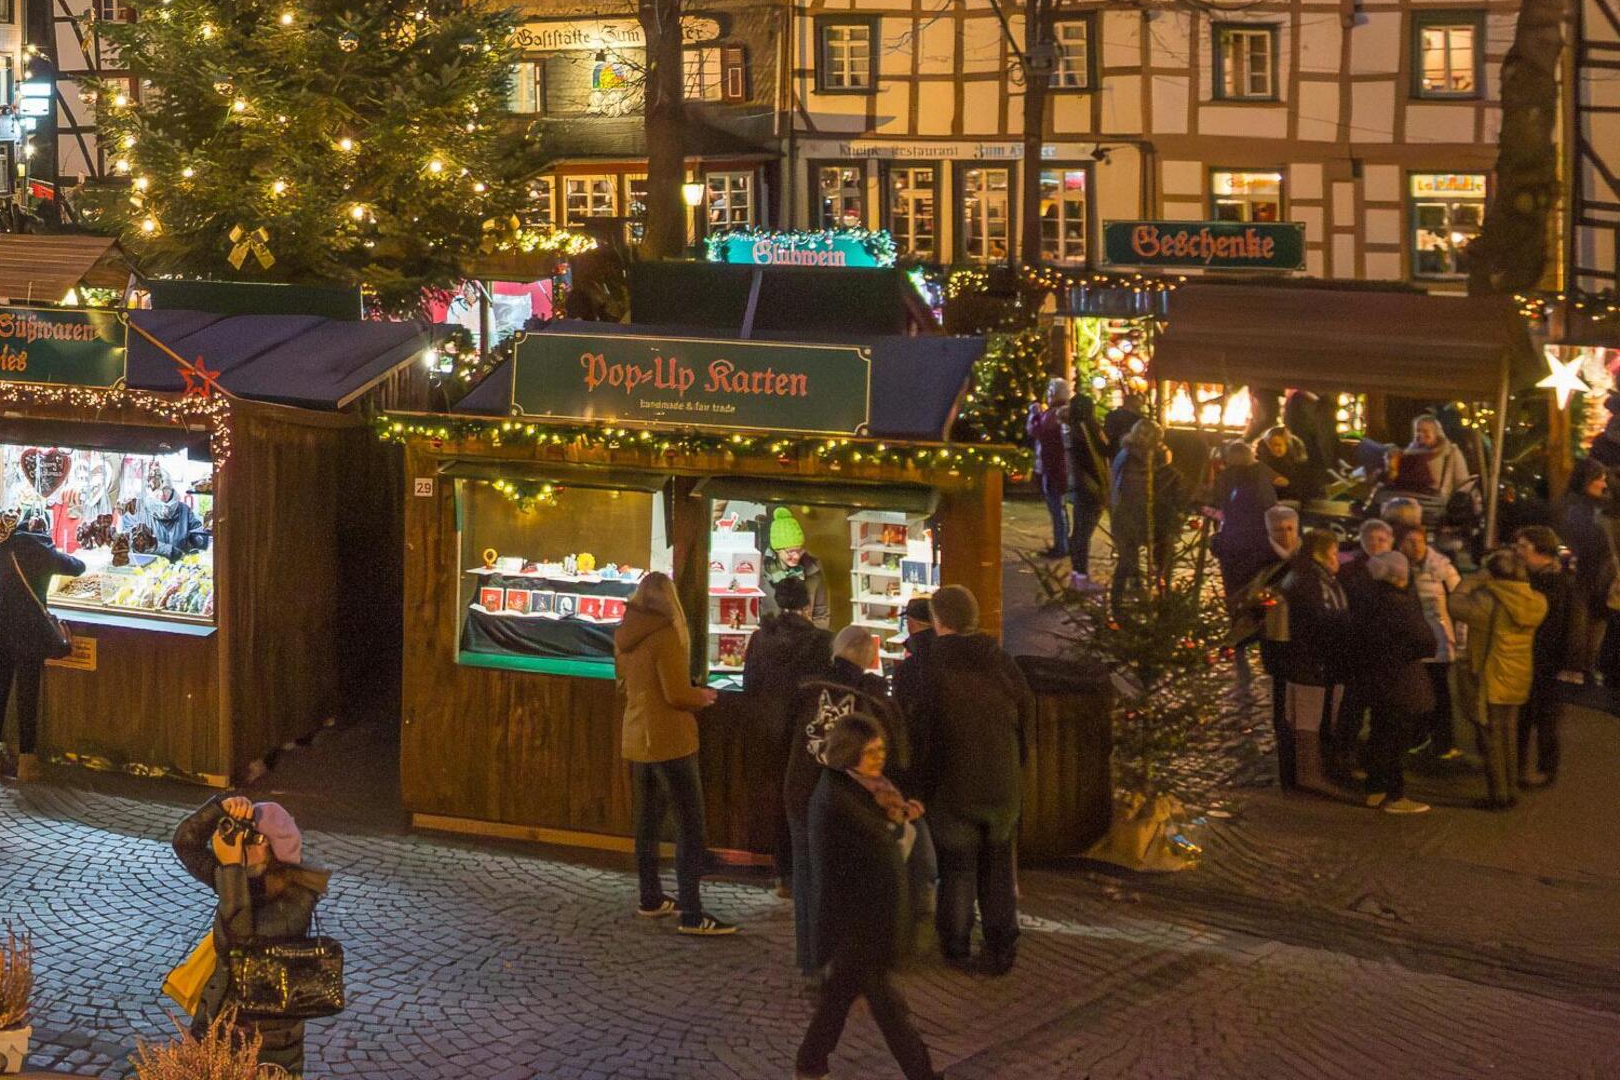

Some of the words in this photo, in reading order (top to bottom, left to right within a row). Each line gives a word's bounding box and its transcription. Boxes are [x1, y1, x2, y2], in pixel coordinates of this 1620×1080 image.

[1132, 225, 1275, 264] Geschenke
[580, 353, 694, 396] Pop-Up
[704, 359, 807, 397] Karten
[416, 482, 432, 494] 29
